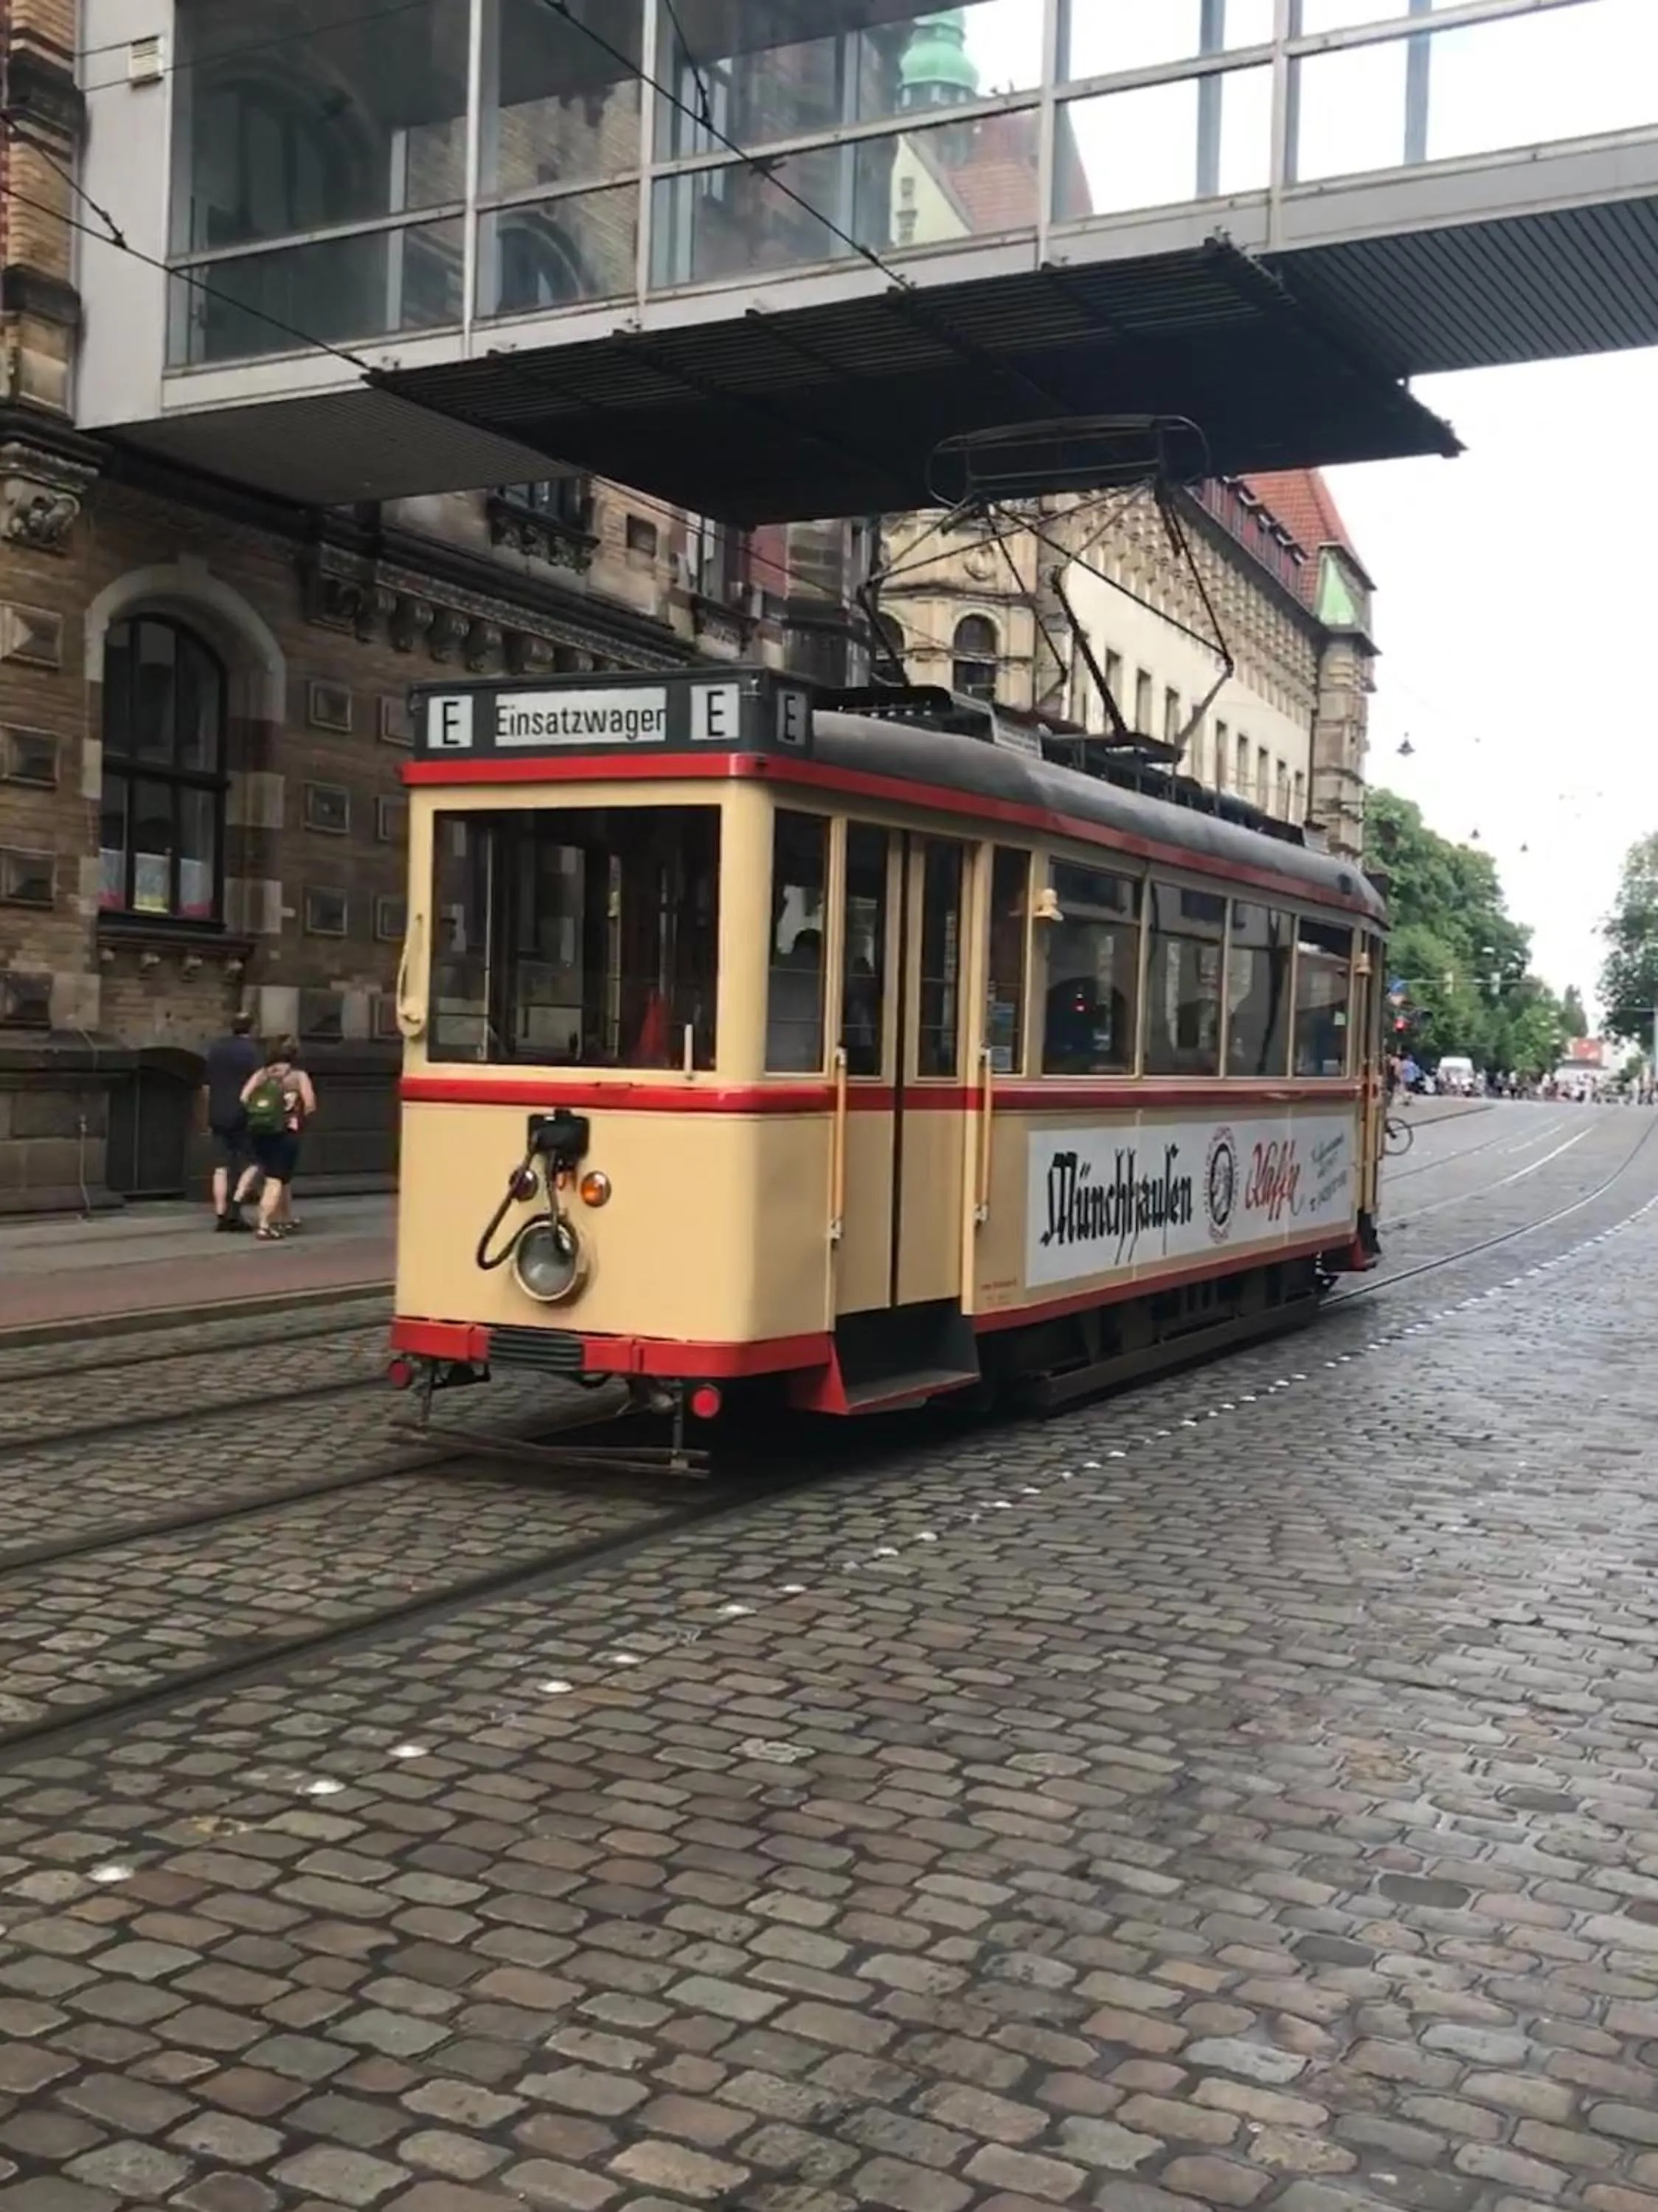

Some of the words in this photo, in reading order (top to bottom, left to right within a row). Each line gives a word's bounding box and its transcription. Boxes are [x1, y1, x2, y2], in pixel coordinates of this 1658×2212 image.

[443, 701, 460, 744] E
[496, 705, 666, 740] Einsatzwagen
[707, 690, 725, 737] E
[784, 694, 796, 741] E
